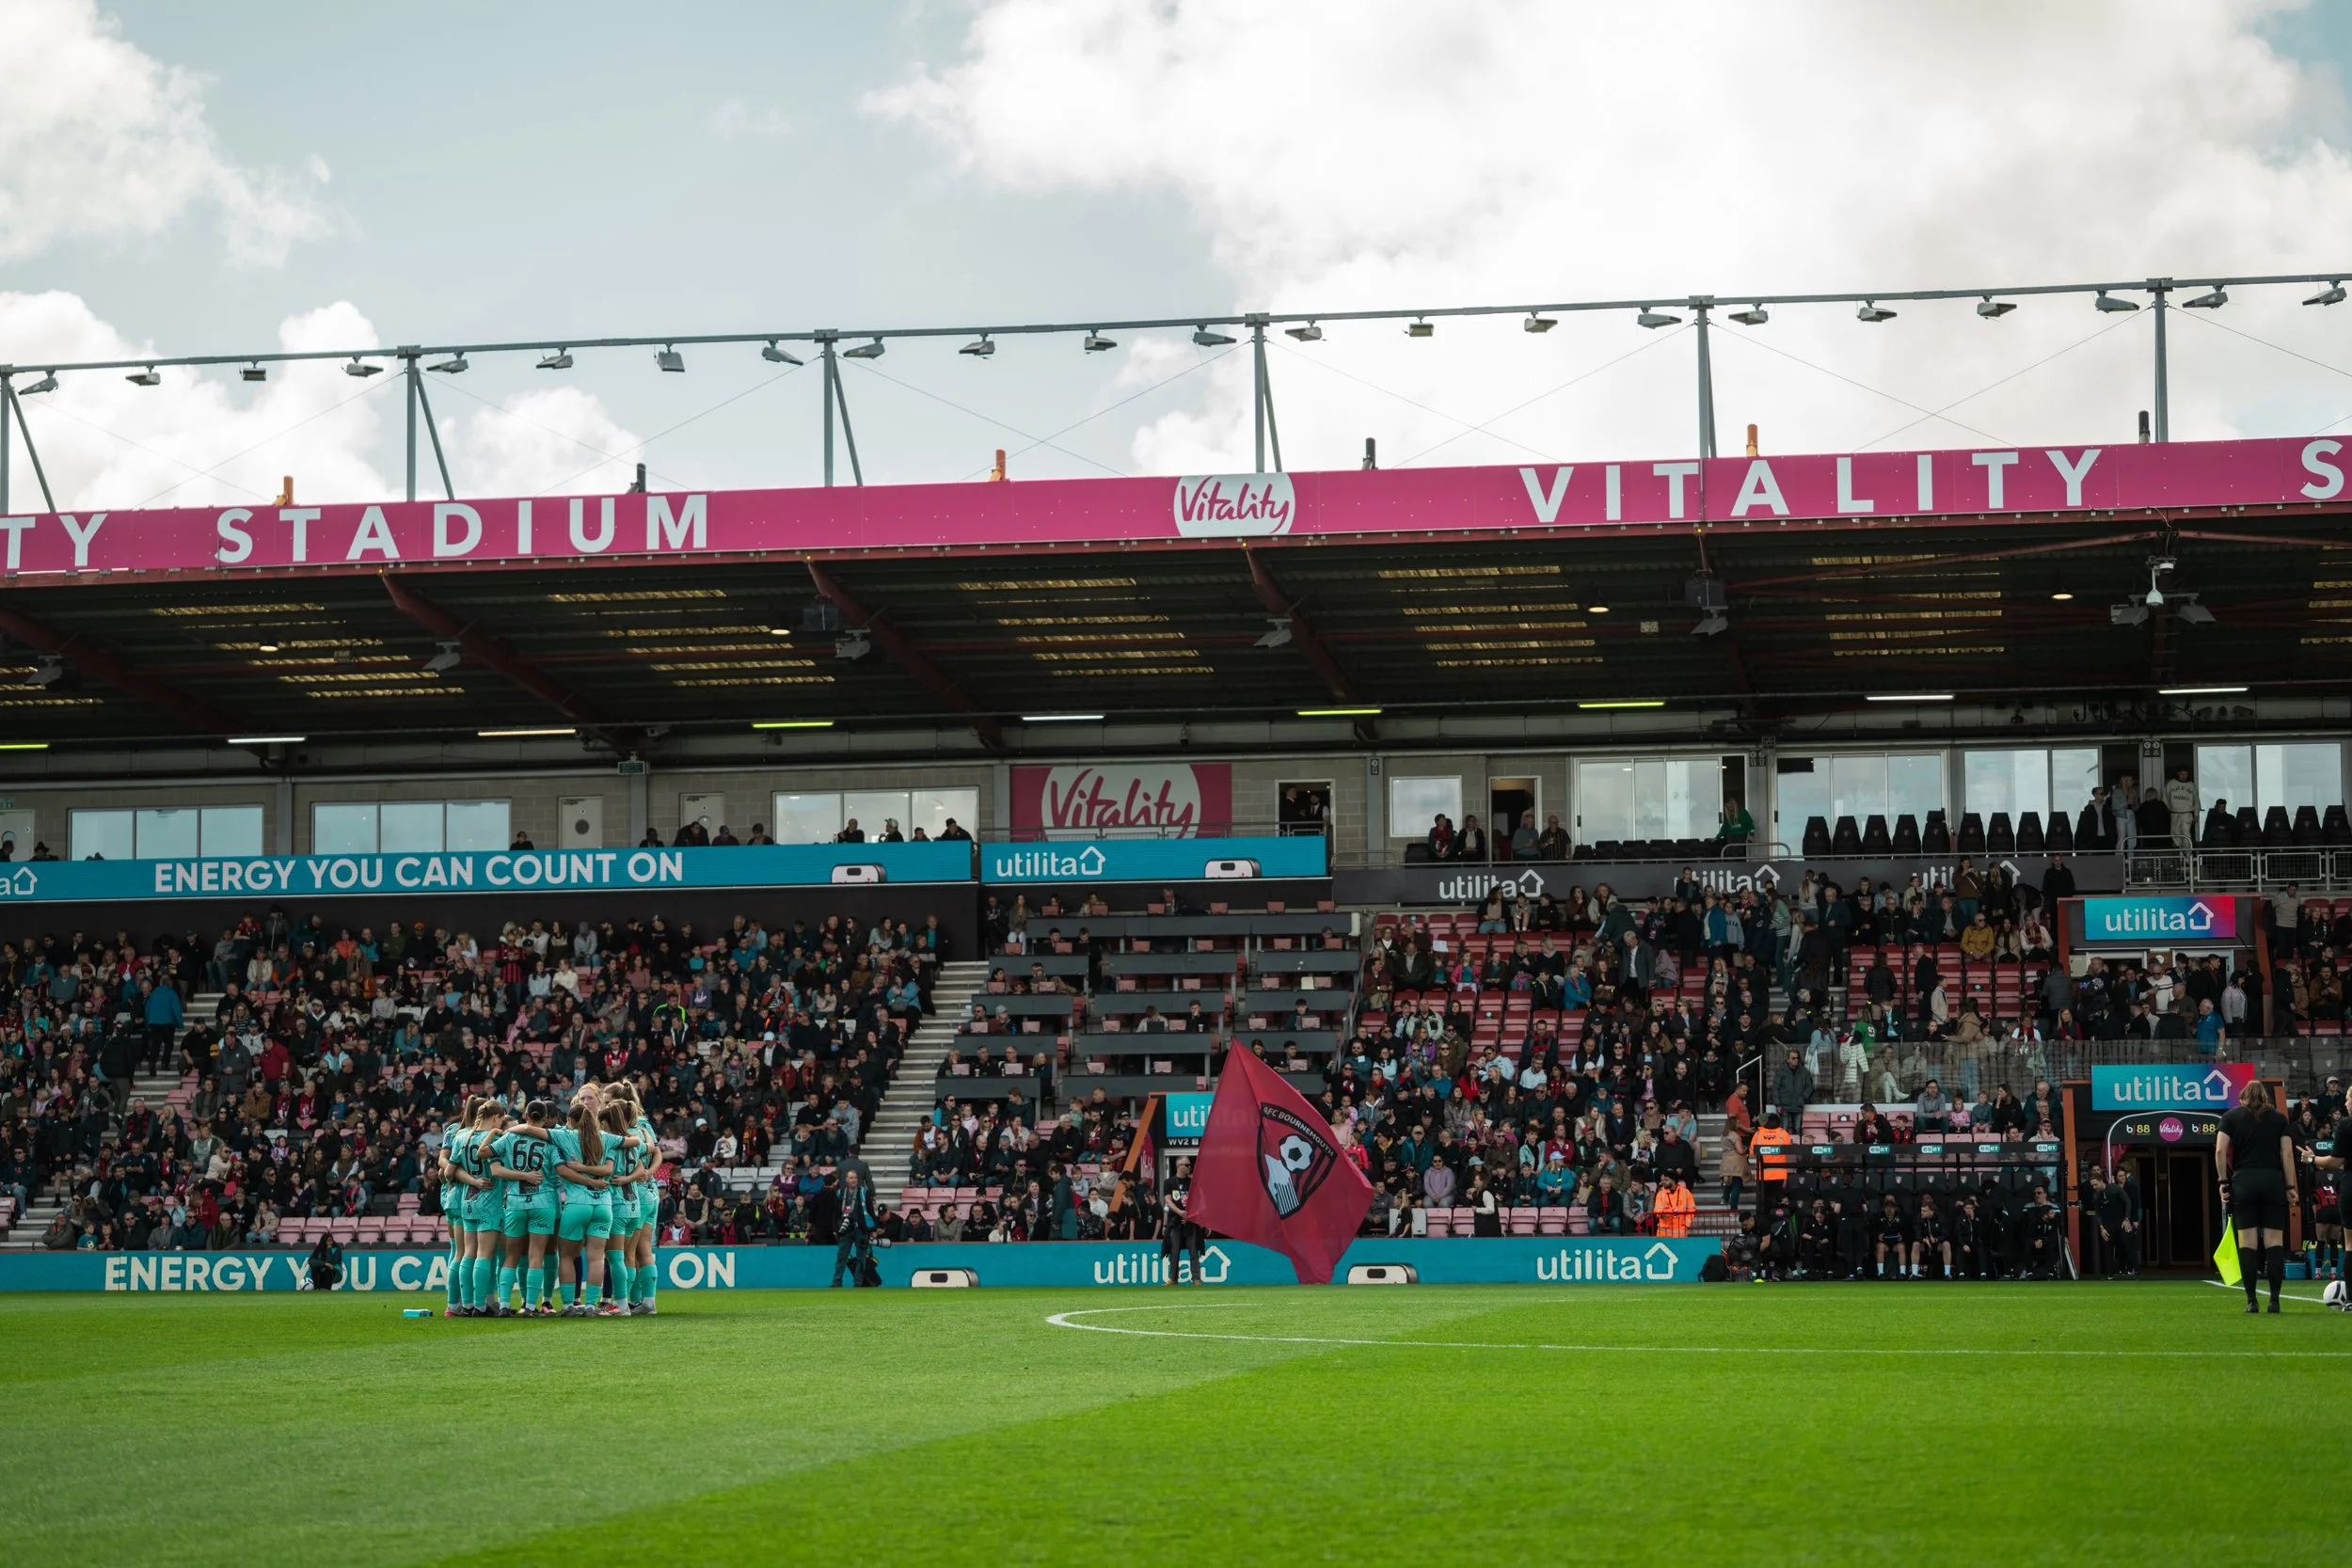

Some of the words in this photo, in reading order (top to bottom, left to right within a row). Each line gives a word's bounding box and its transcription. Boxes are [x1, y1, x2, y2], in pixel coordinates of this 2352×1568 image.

[1518, 449, 2102, 522] VITALITY
[1181, 475, 1290, 534] Vitality
[0, 514, 108, 568] TY
[215, 494, 707, 563] STADIUM
[1050, 768, 1194, 839] Vitality
[154, 860, 296, 893] ENERGY
[307, 858, 383, 889] YOU
[394, 856, 472, 887] CAN
[485, 853, 616, 885] COUNT
[628, 851, 683, 882] ON
[996, 852, 1077, 878] utilita
[1439, 875, 1517, 899] utilita
[2106, 908, 2186, 932] utilita
[2114, 1075, 2202, 1101] utilita
[1263, 1106, 1279, 1117] AFC
[1278, 1111, 1334, 1157] BOURNEMOUTH
[2159, 1123, 2183, 1135] Vitality
[513, 1139, 545, 1171] 66
[104, 1256, 273, 1291] ENERGY
[391, 1256, 448, 1291] CA
[668, 1252, 735, 1289] ON
[1094, 1253, 1193, 1284] utilita
[1536, 1249, 1642, 1280] utilita
